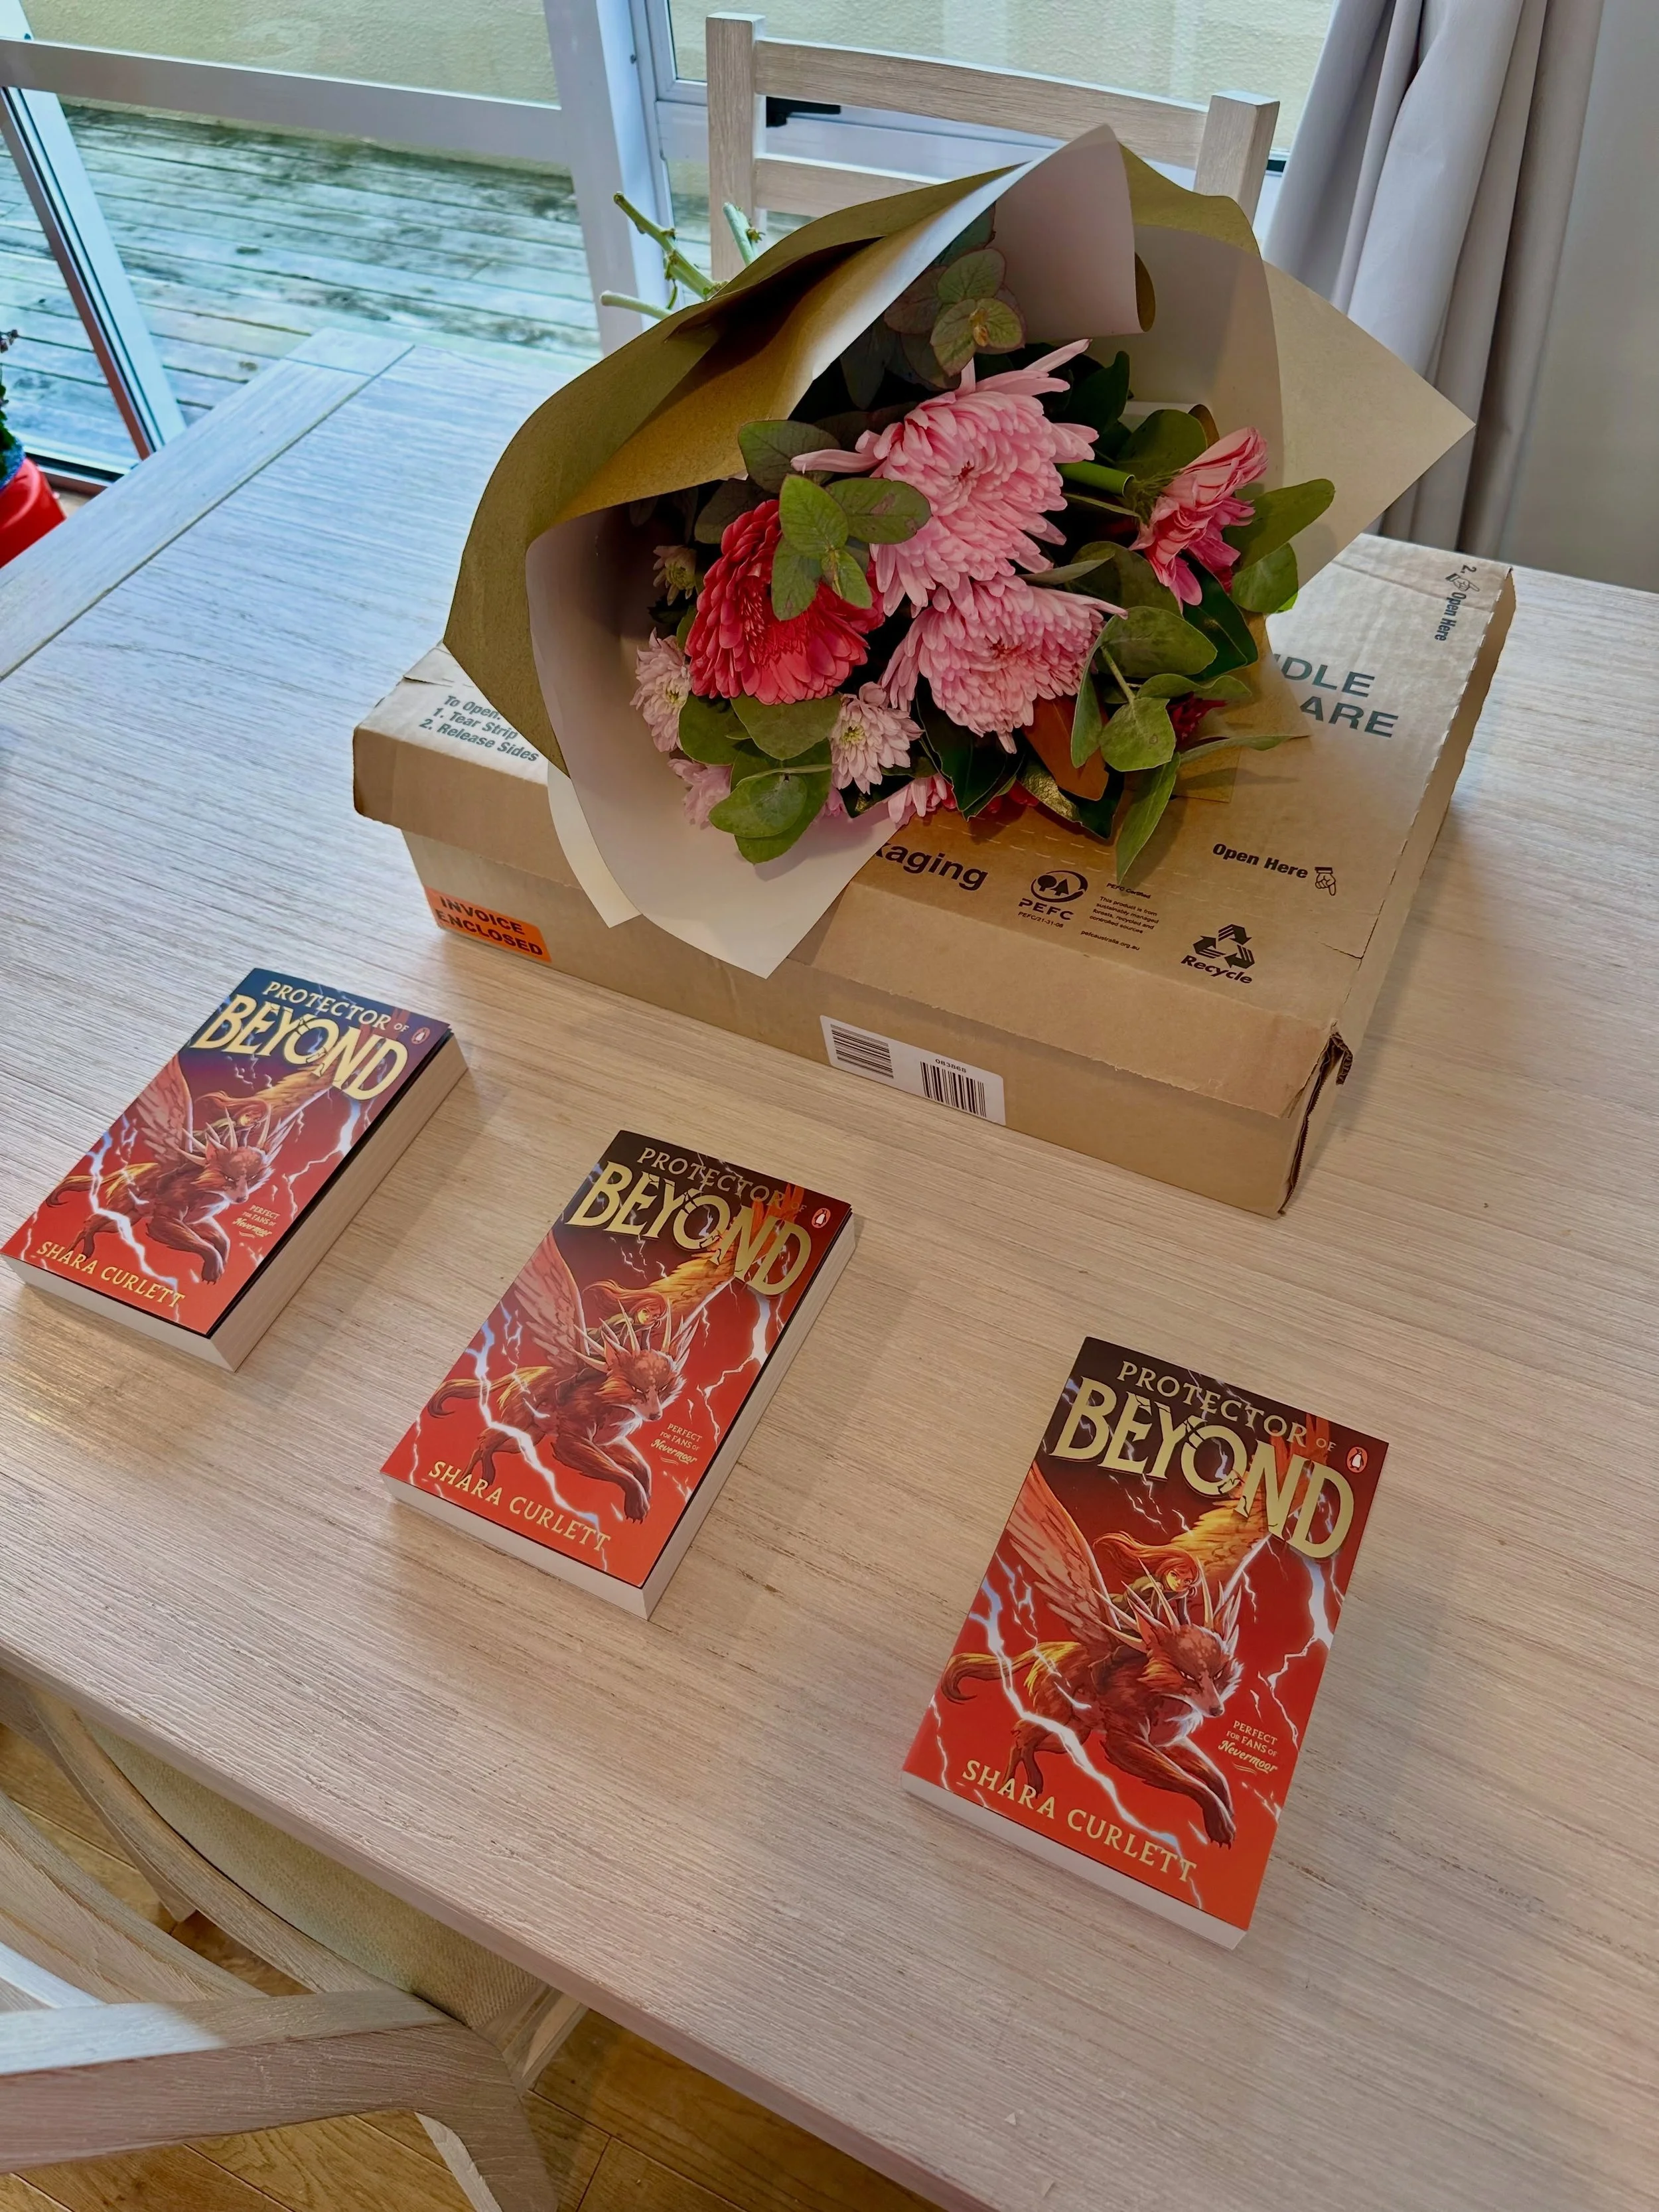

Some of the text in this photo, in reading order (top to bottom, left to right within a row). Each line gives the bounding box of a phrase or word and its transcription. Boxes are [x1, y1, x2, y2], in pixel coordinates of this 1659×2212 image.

[1434, 565, 1477, 641] 2. Open Here
[1273, 653, 1375, 698] DLE
[444, 696, 461, 707] To
[433, 707, 518, 740] 1. Tear Strip
[419, 719, 539, 761] 2. Release Sides
[1212, 844, 1309, 879] Open Here
[1106, 883, 1151, 899] PEFC Certified
[1113, 899, 1136, 910] product
[440, 897, 526, 935] INVOICE
[1018, 897, 1074, 921] PEFC
[1089, 915, 1143, 934] controlled sources
[1093, 909, 1114, 919] forests,
[1116, 915, 1141, 926] recycled
[1096, 903, 1159, 924] sustainably managed
[435, 909, 543, 956] ENCLOSED
[1080, 930, 1140, 950] pefcaustralia.org.au
[1181, 954, 1253, 984] Recycle
[263, 981, 409, 1032] PROTECTOR OF
[191, 994, 408, 1100] BEYOND
[637, 1147, 807, 1213] PROTECTOR OF
[232, 1218, 272, 1237] Nevermoor
[250, 1205, 280, 1219] PERFECT
[252, 1215, 270, 1224] FANS
[565, 1161, 812, 1295] BEYOND
[36, 1241, 185, 1307] SHARA CURLETT
[1117, 1361, 1336, 1452] PROTECTOR OF
[667, 1423, 702, 1442] PERFECT
[671, 1436, 692, 1448] FANS
[651, 1439, 697, 1465] Nevermoor
[1049, 1376, 1354, 1558] BEYOND
[428, 1461, 611, 1552] SHARA CURLETT
[1226, 1731, 1240, 1741] FOR
[1241, 1736, 1267, 1753] FANS
[1233, 1720, 1277, 1745] PERFECT
[1218, 1740, 1278, 1774] Nevermoor
[962, 1760, 1197, 1883] SHARA CURLETT
